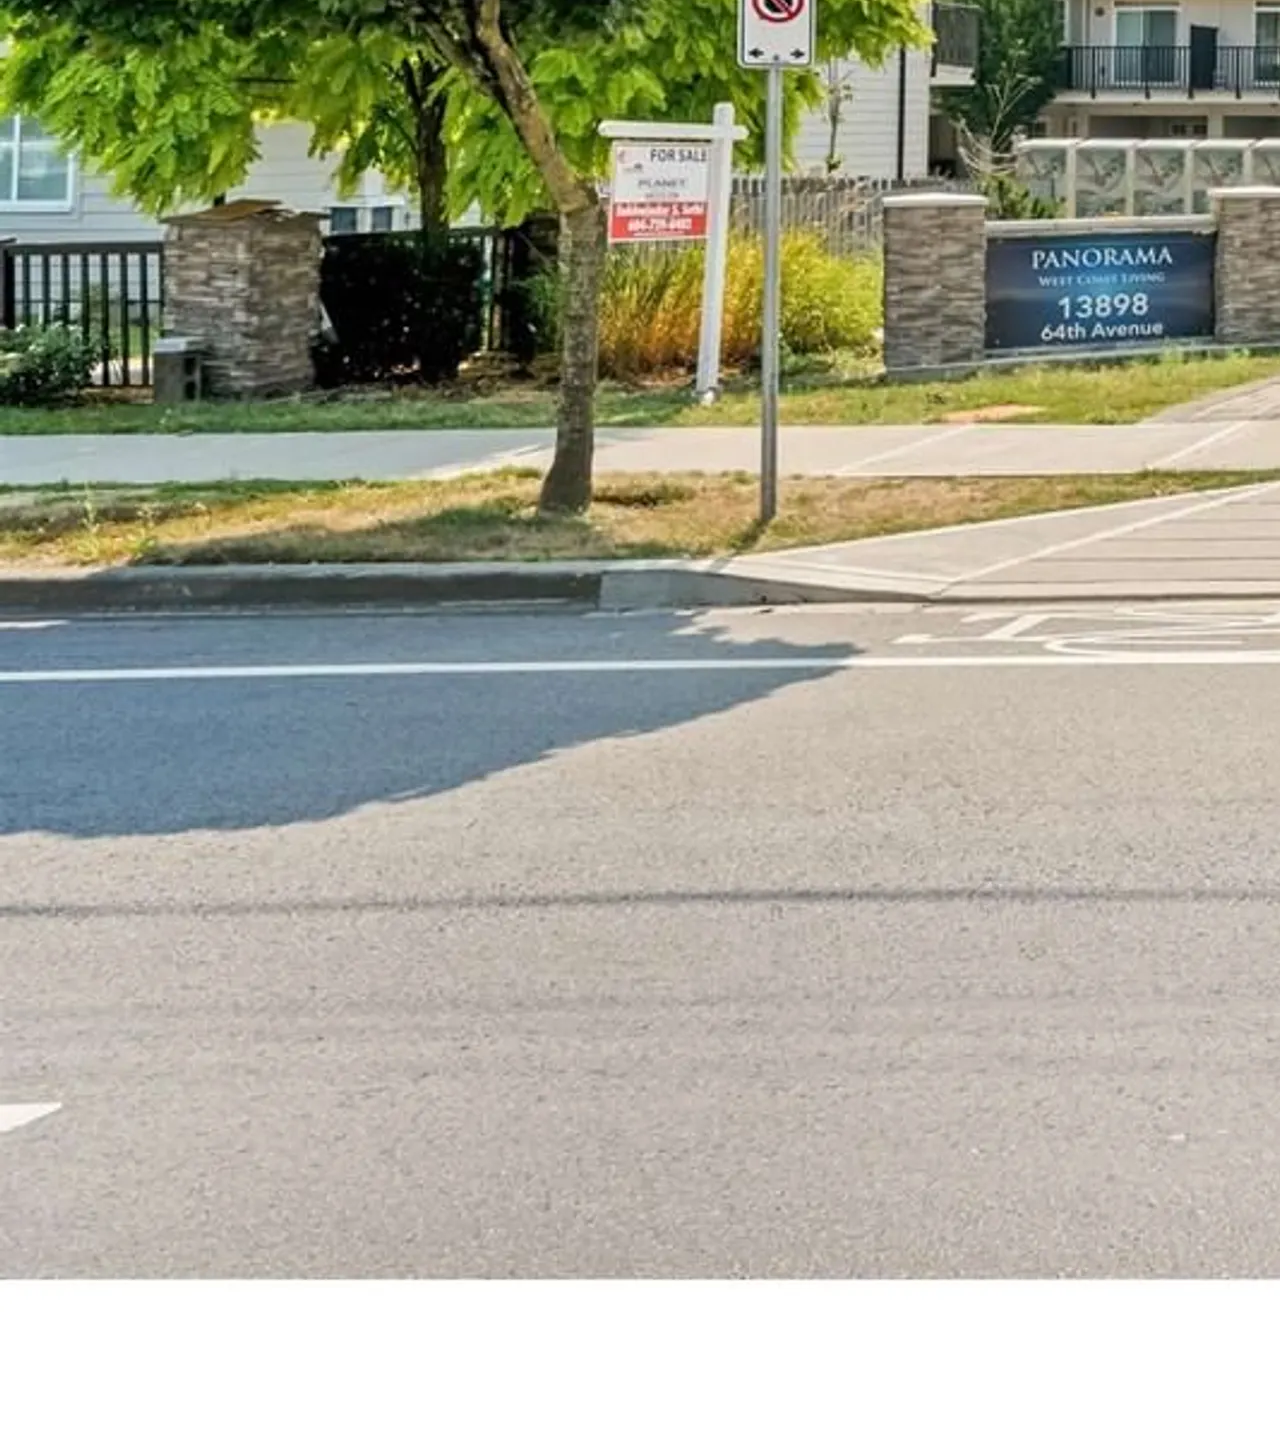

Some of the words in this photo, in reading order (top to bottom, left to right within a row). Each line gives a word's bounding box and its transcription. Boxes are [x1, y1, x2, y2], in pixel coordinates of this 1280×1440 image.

[650, 148, 676, 161] FOR
[679, 148, 707, 161] SALE
[1031, 246, 1174, 270] PANORAMA
[1057, 292, 1150, 320] 13898
[1040, 323, 1087, 342] 64th
[1090, 321, 1164, 340] Avenue
